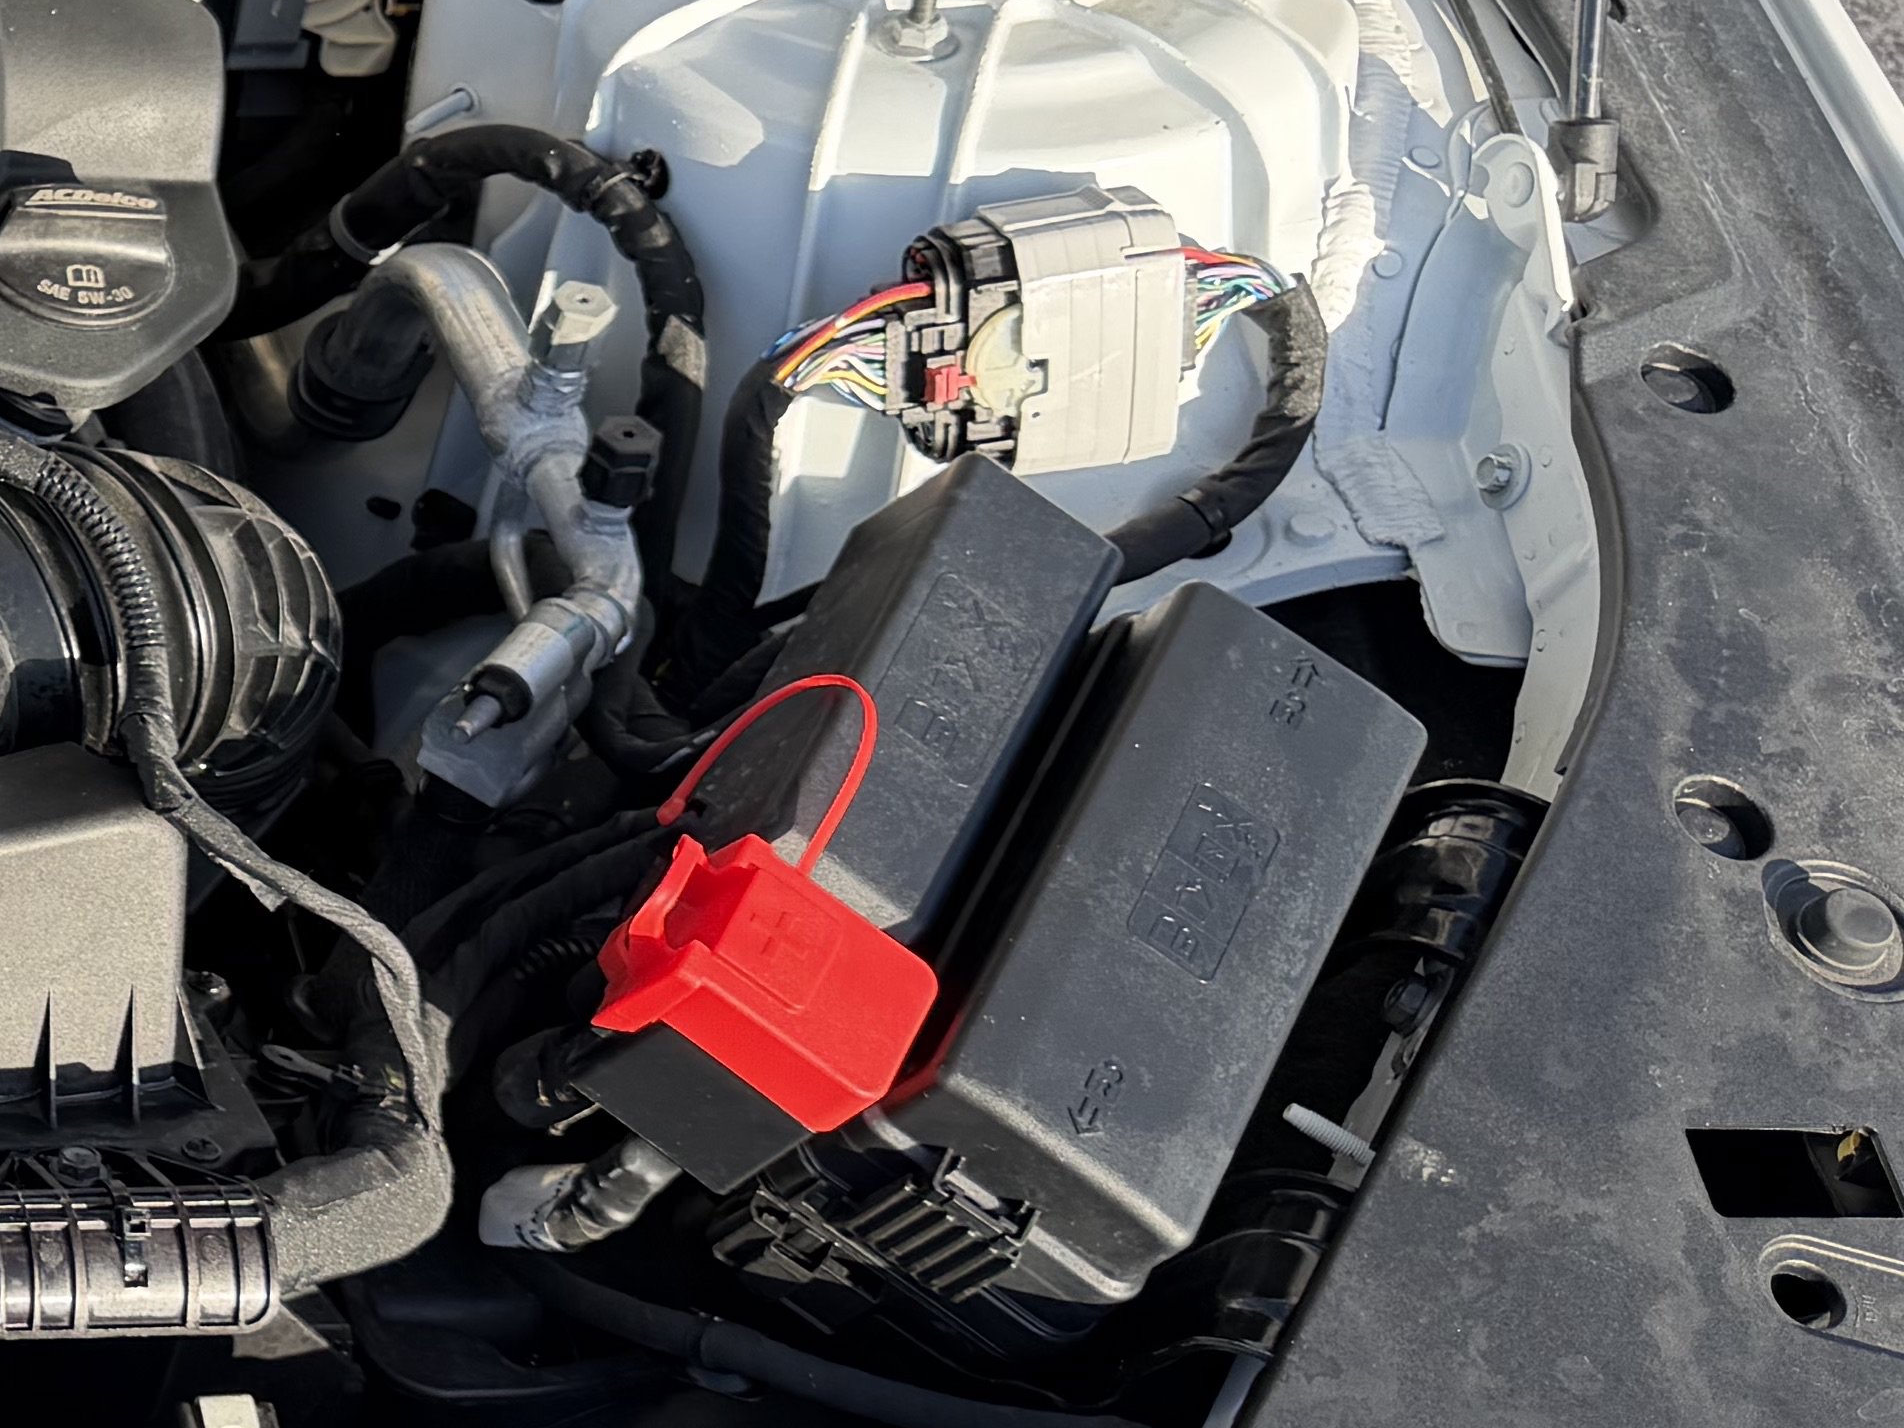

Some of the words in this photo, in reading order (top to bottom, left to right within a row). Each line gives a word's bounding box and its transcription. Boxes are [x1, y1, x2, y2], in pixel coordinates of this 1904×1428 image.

[28, 188, 158, 209] ACDelco
[37, 278, 72, 302] SAE
[78, 285, 136, 305] 5W-30
